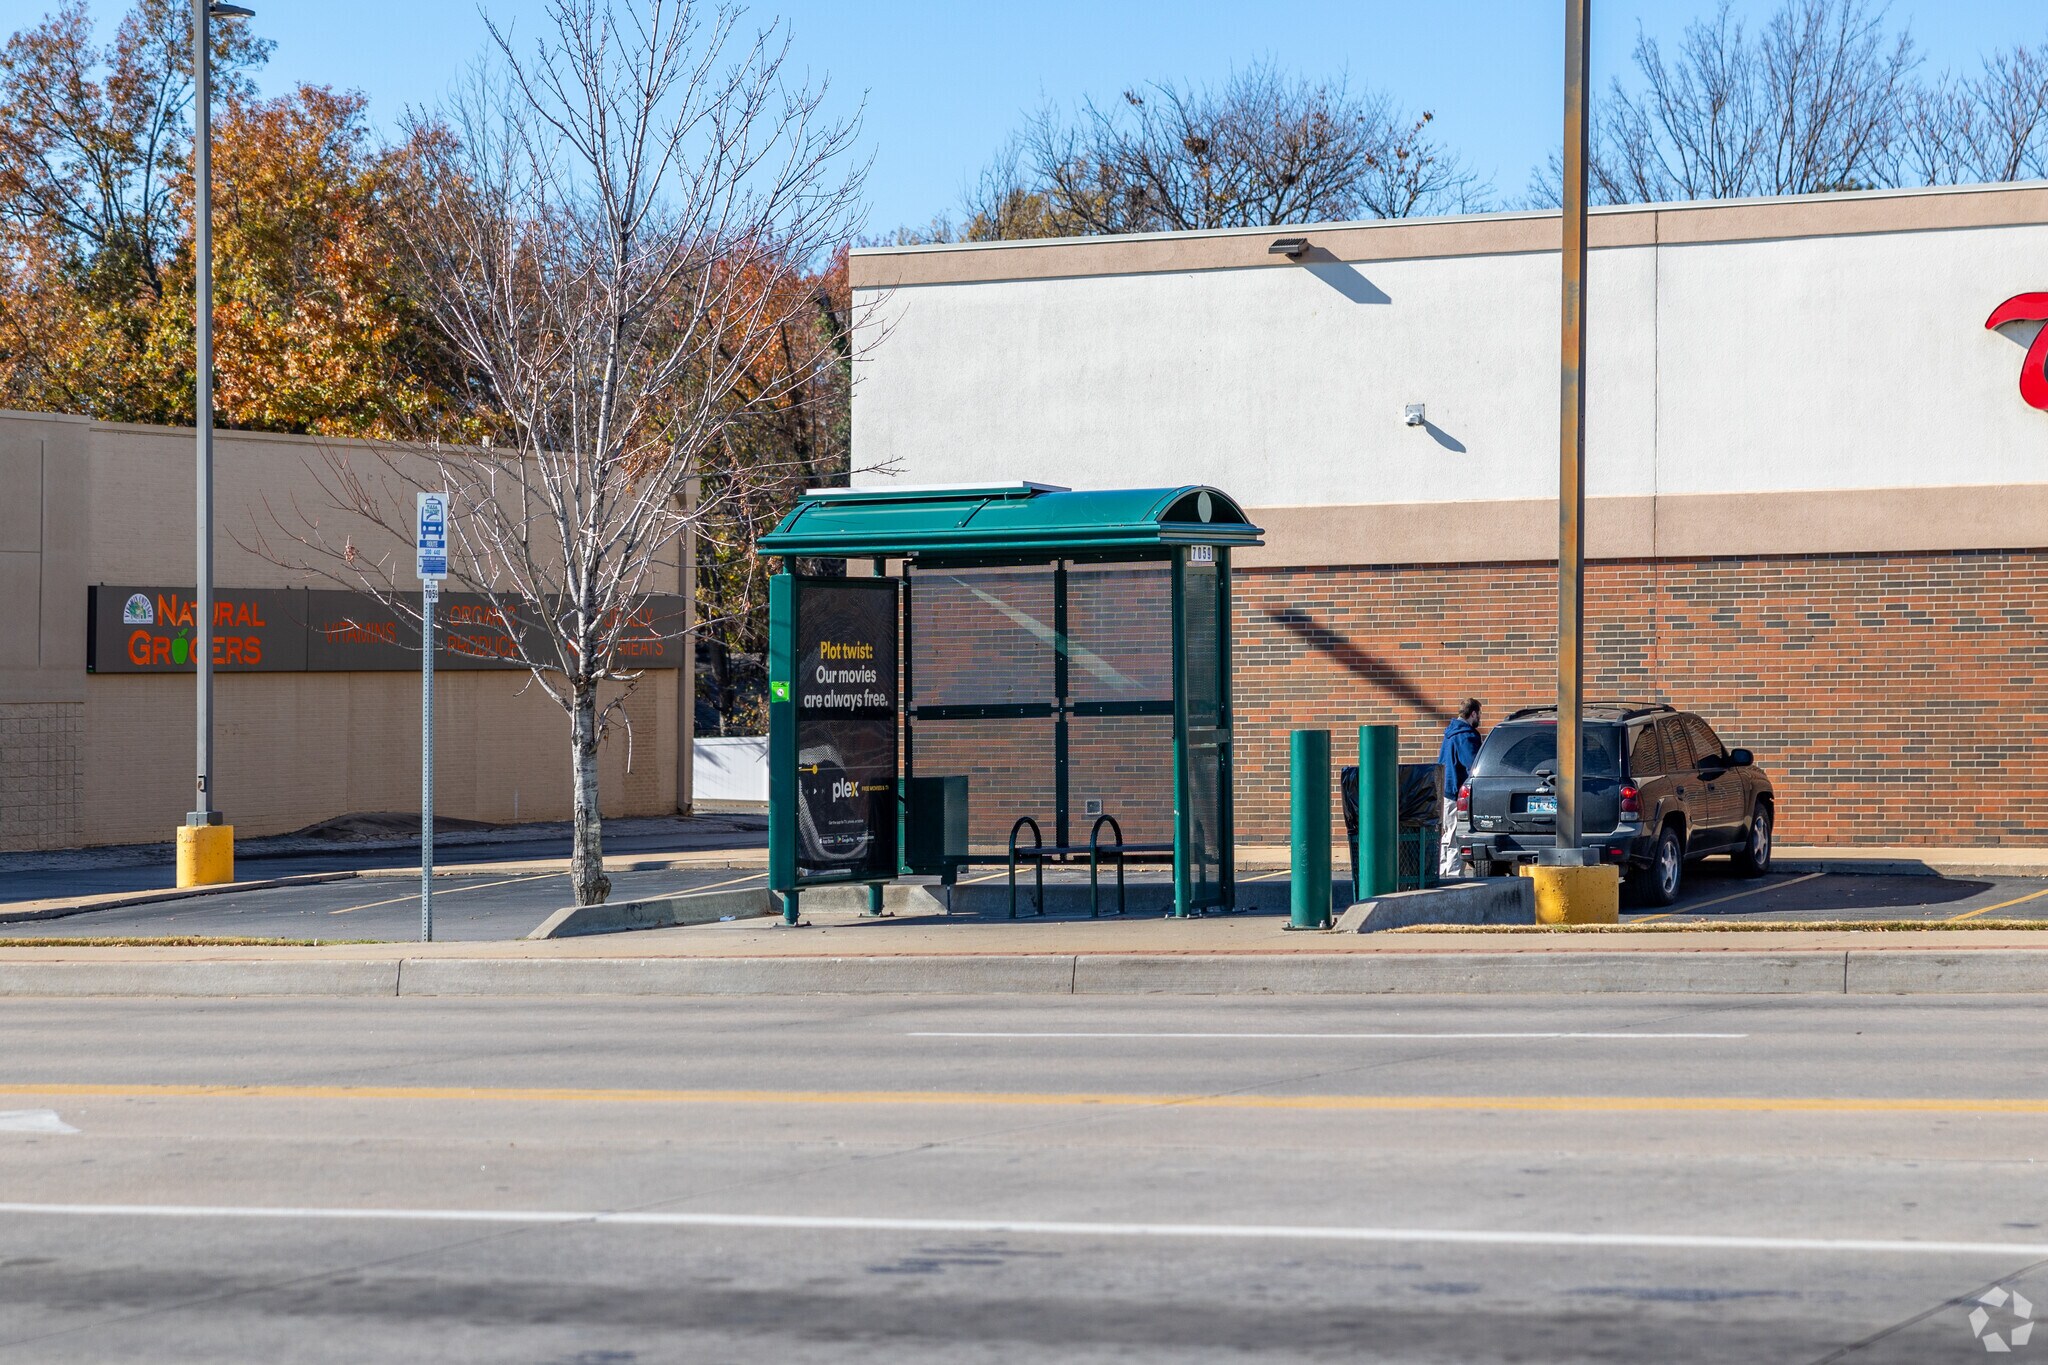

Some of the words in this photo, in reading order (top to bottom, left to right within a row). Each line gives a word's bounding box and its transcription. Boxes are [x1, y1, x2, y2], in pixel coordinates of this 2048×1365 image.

[1192, 547, 1211, 560] 7059
[323, 621, 397, 644] VITAMINS
[820, 641, 841, 660] Plot
[842, 641, 873, 660] twist:
[816, 665, 837, 684] Our
[838, 665, 877, 684] movies
[804, 693, 823, 709] are
[824, 689, 863, 712] always
[864, 688, 889, 707] free.
[832, 777, 859, 803] plex
